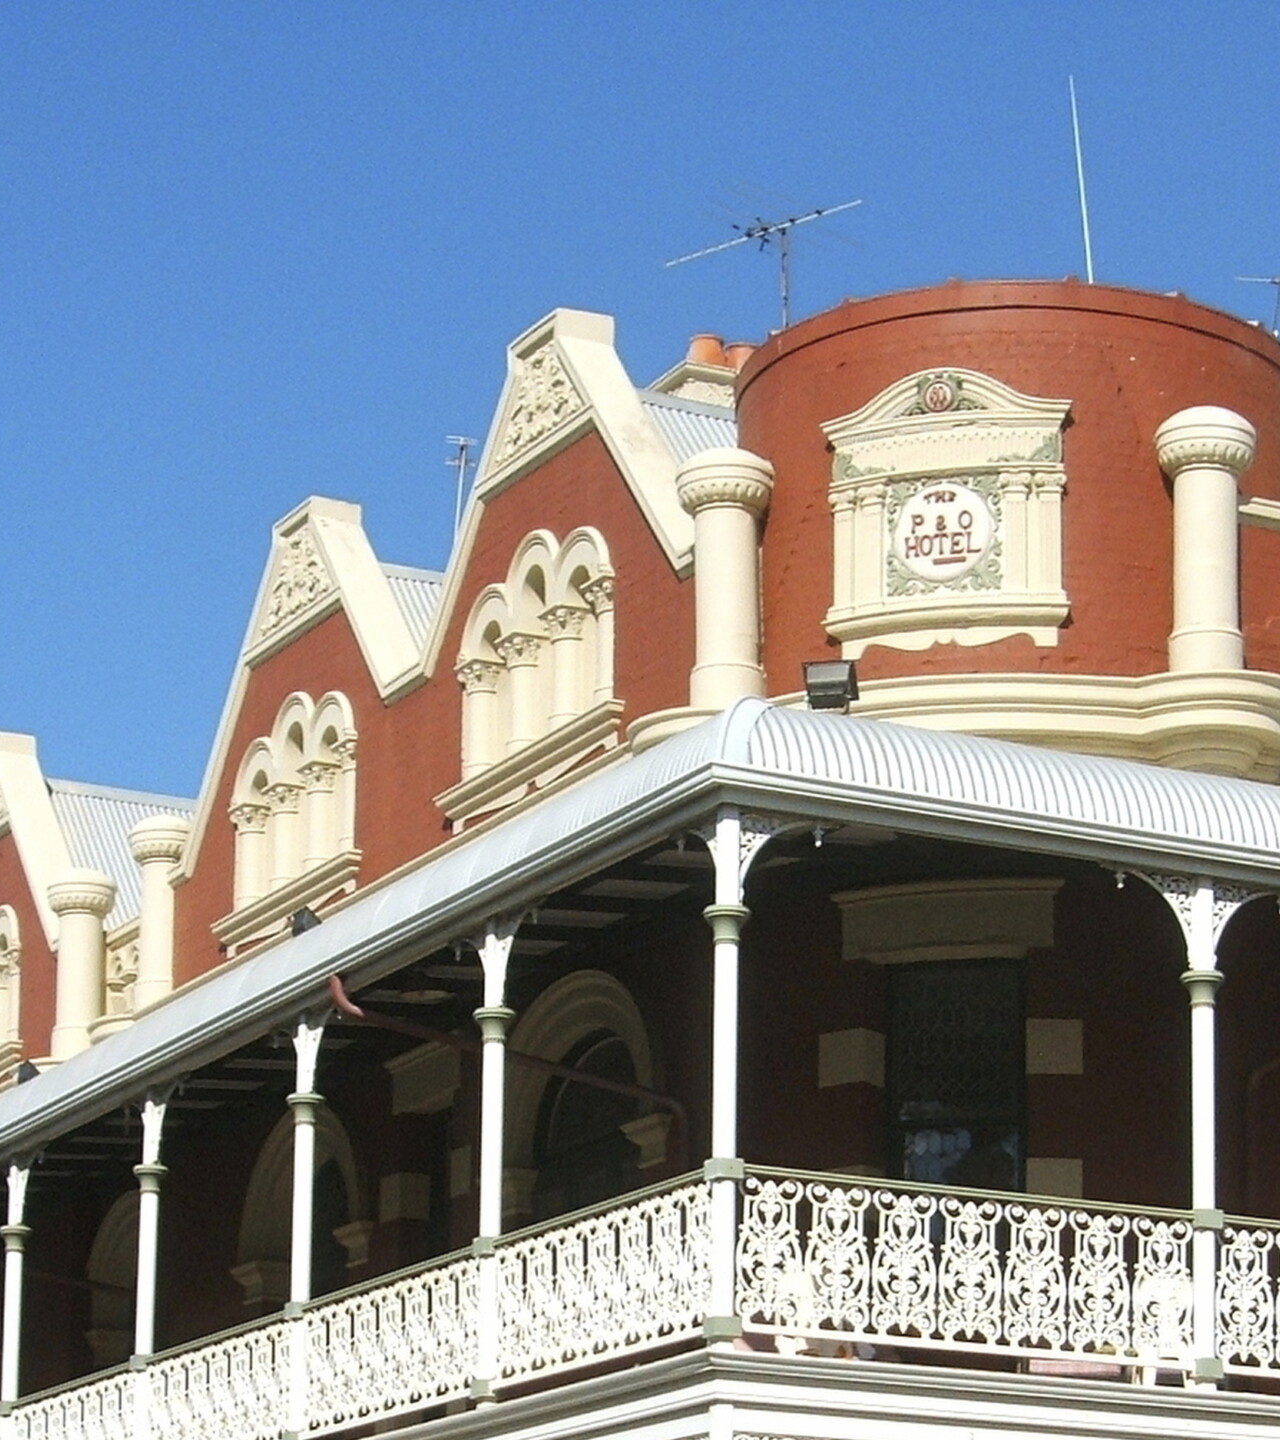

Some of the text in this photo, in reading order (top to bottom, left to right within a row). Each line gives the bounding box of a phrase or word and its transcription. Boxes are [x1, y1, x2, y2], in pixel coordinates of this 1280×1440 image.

[923, 490, 957, 504] THE
[911, 509, 974, 535] P & O
[905, 531, 981, 559] HOTEL
